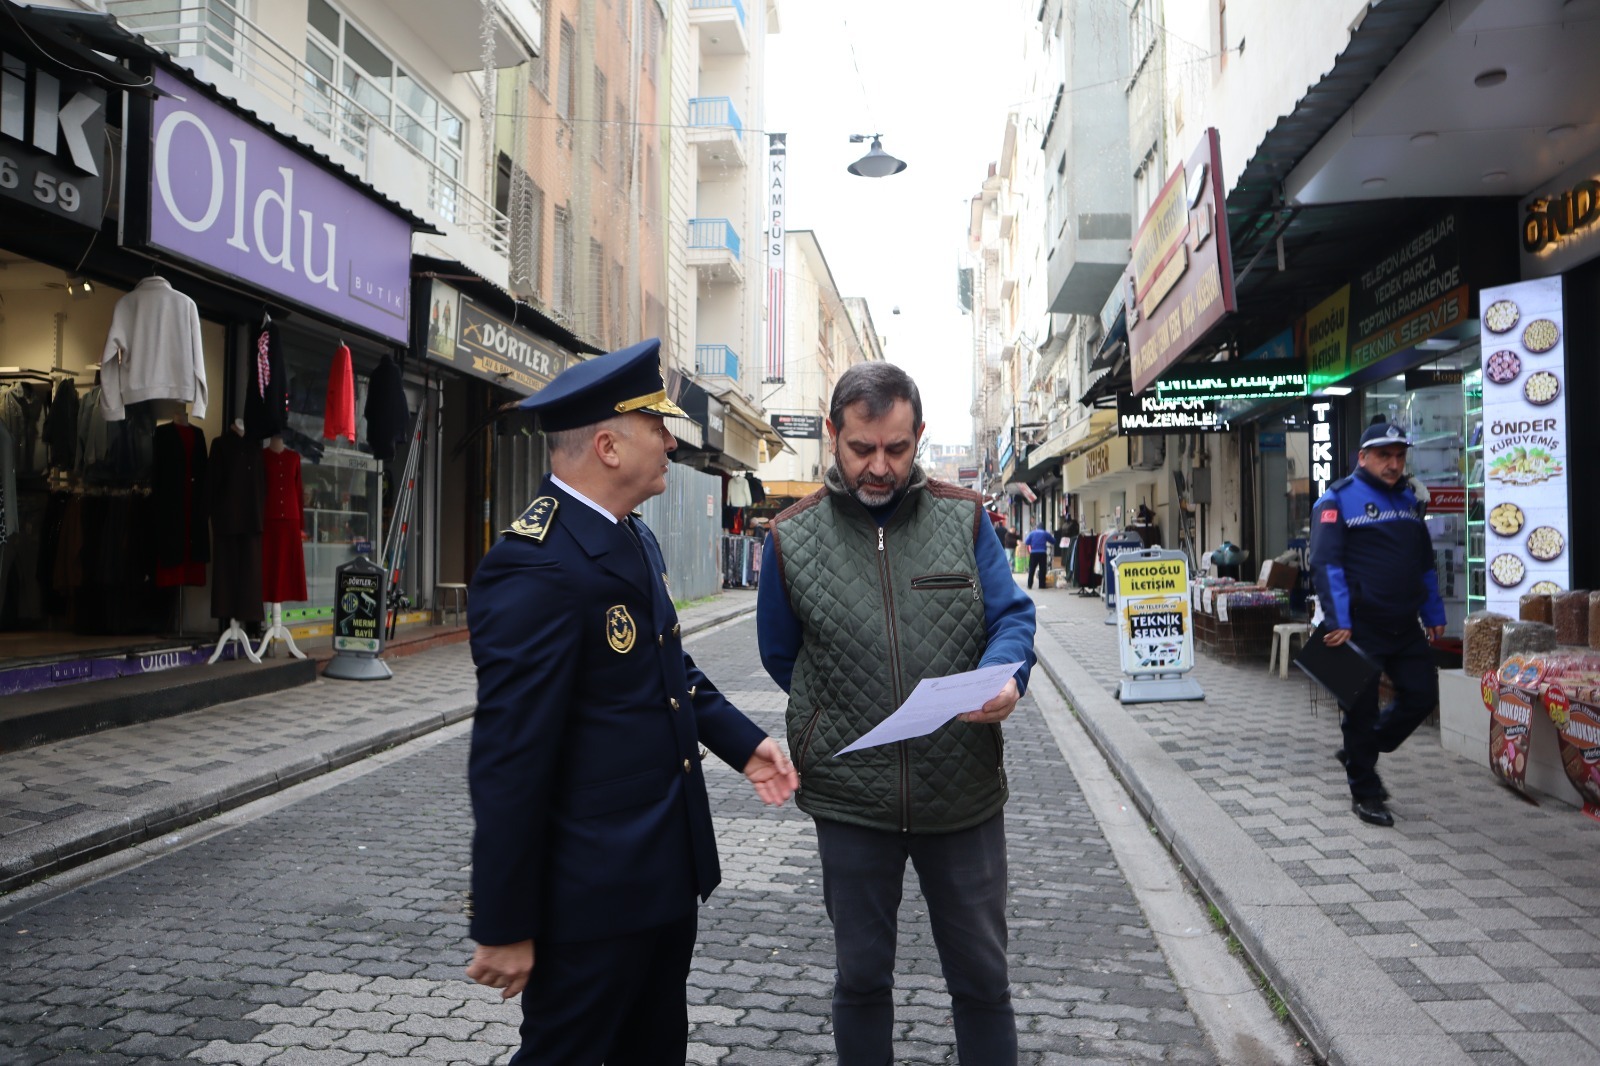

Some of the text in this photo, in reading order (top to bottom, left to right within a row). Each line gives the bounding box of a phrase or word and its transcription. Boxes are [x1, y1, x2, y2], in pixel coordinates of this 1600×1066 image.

[33, 170, 80, 213] 59
[155, 110, 339, 292] Oldu
[1361, 214, 1455, 290] TELEFON AKSESUAR
[1374, 254, 1437, 305] YEDEK PARÇA
[1358, 307, 1392, 337] TOPTAN
[1397, 265, 1460, 315] PARAKENDE
[1308, 304, 1345, 344] HACIOĞLU
[1355, 298, 1459, 369] TEKNİK SERVİS
[482, 323, 549, 376] DÖRTLER
[1312, 338, 1342, 374] İLETİŞİM
[1490, 417, 1557, 436] ÖNDER
[1490, 433, 1560, 455] KURUYEMİŞ
[349, 576, 372, 586] DÖRTLER
[1124, 563, 1181, 577] HACIOĞLU
[1131, 577, 1176, 592] İLETİŞİM
[352, 618, 376, 628] MERMİ
[1131, 613, 1181, 627] TEKNİK
[1134, 626, 1180, 639] SERVİS
[1483, 686, 1493, 705] 20
[1549, 703, 1565, 724] 25
